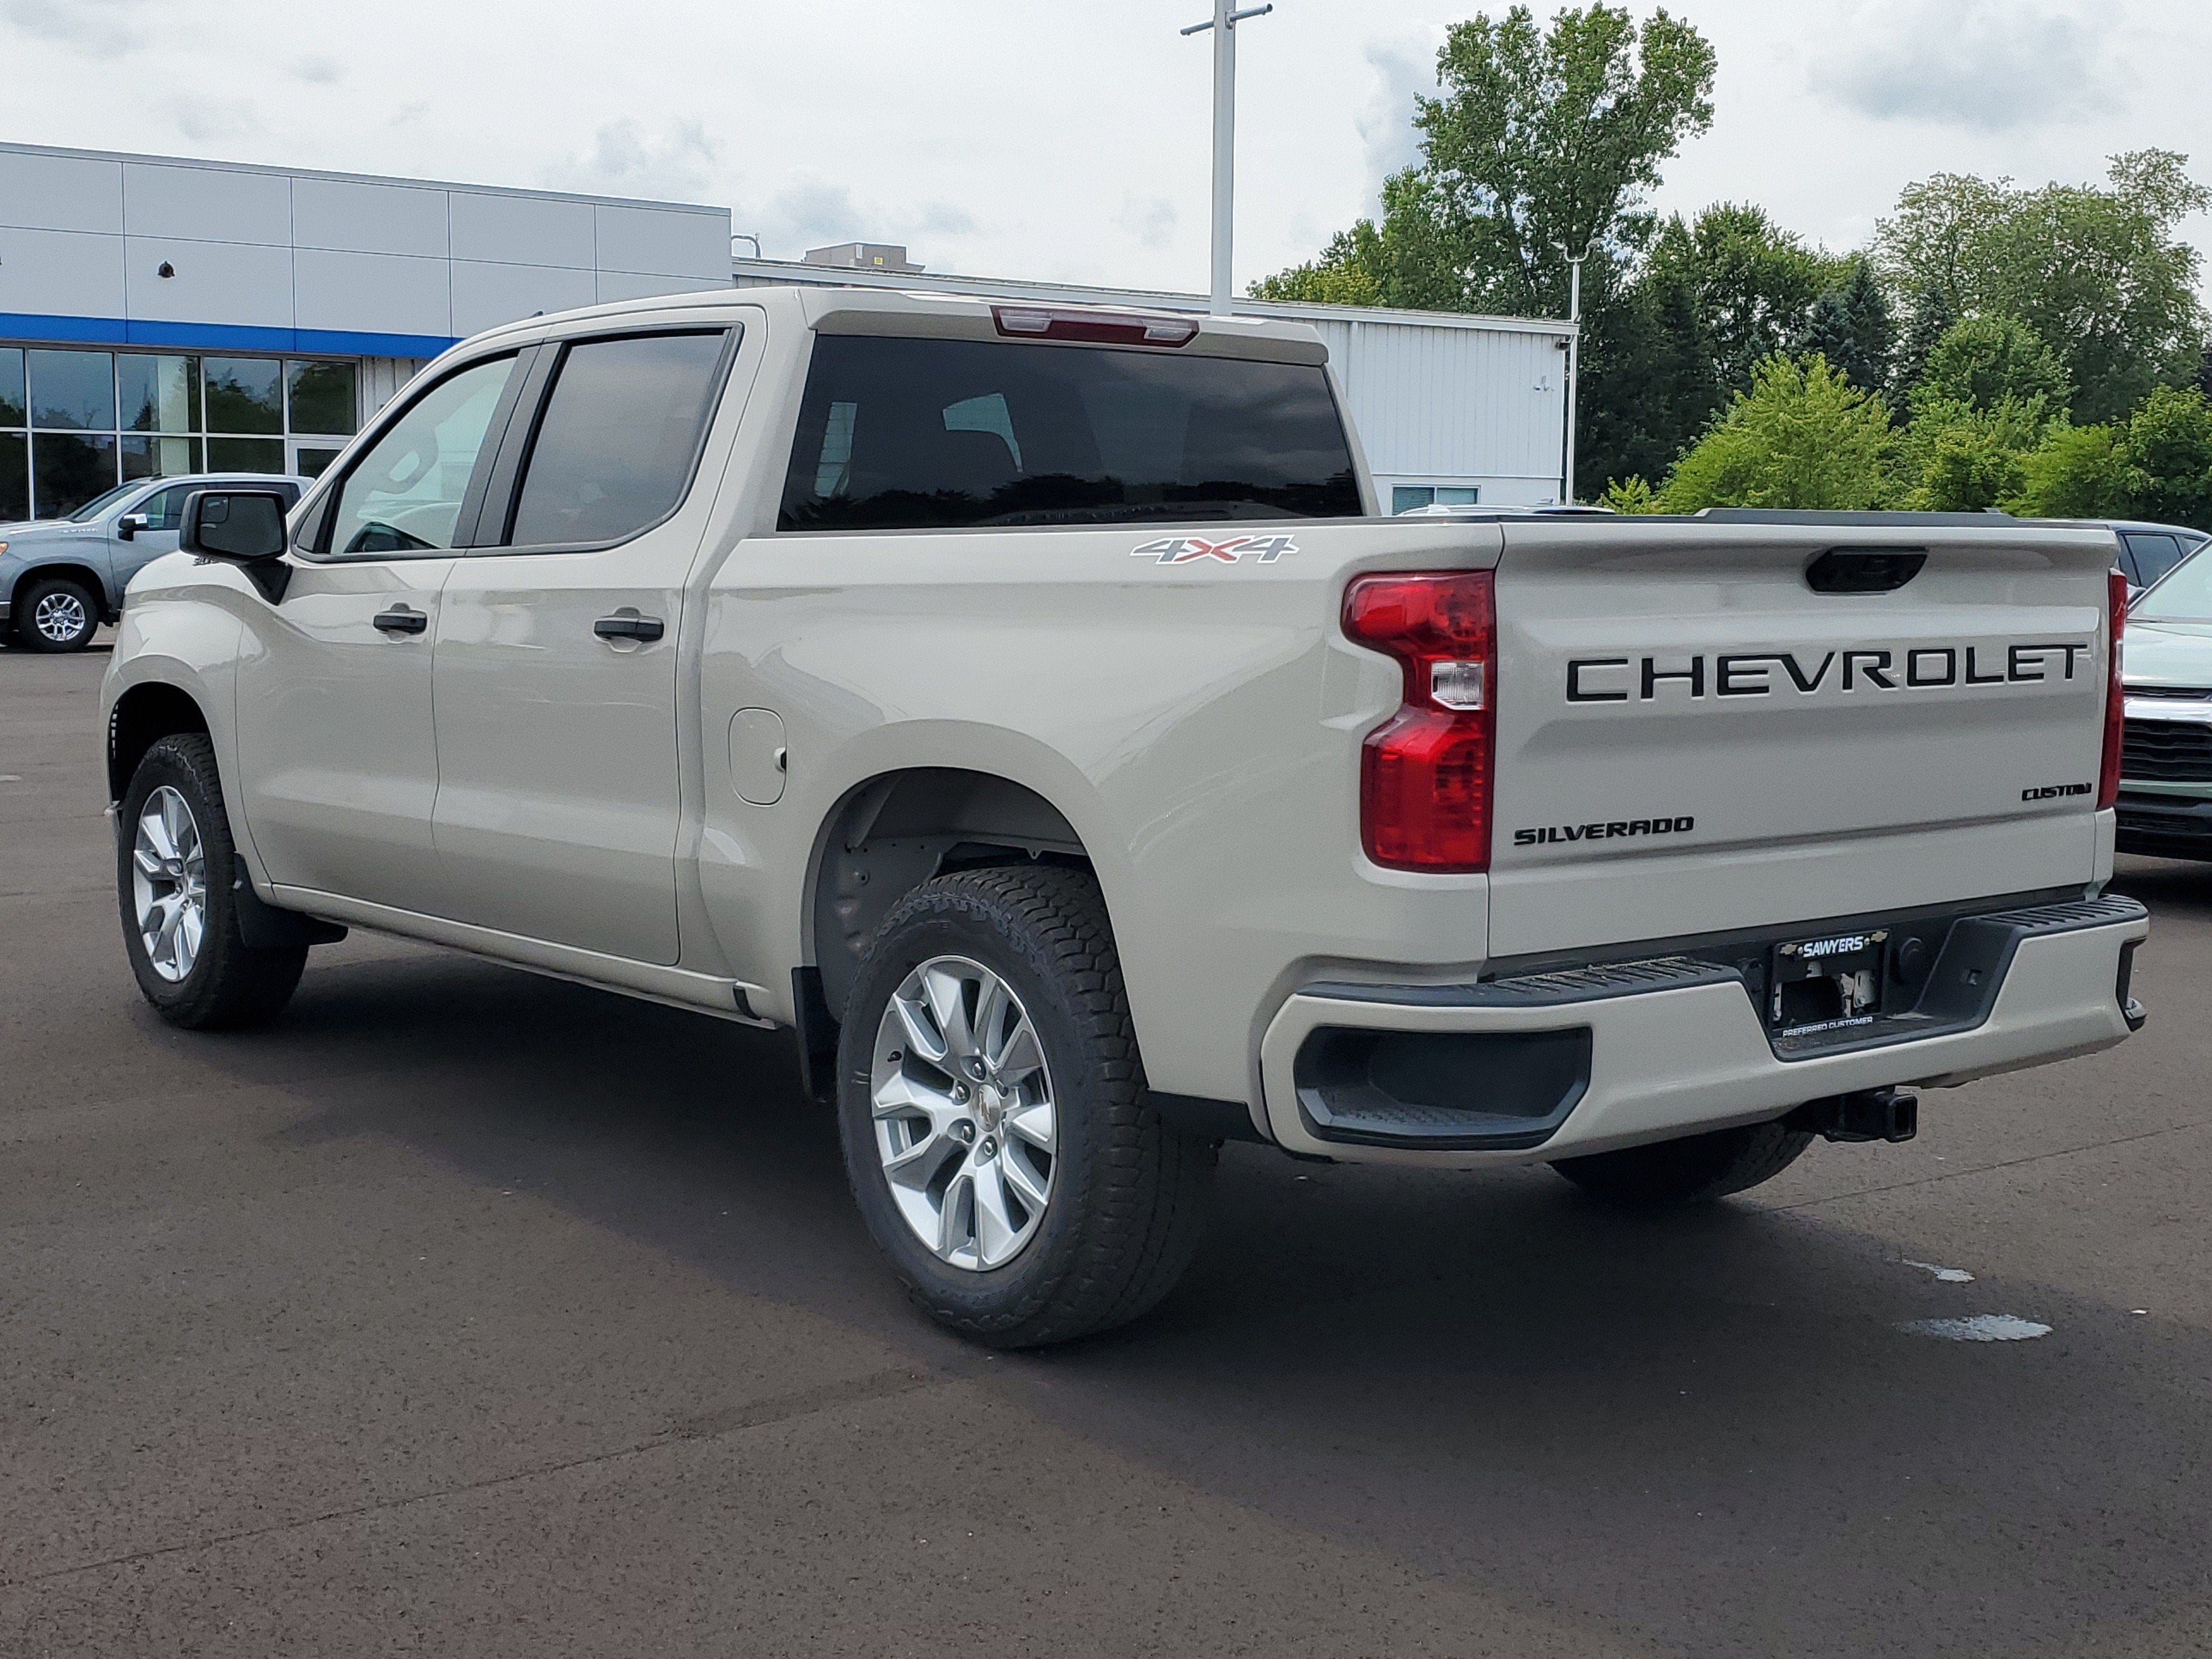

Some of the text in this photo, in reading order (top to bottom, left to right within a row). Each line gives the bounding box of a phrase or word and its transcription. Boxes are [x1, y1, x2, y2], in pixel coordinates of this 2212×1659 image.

[1566, 644, 2088, 702] CHEVROLET
[2022, 782, 2092, 801] CUSTOM
[1513, 816, 1695, 845] SILVERADO
[1803, 936, 1864, 958] SAWYERS
[1783, 1016, 1873, 1037] PREFERRED CUSTOMER
